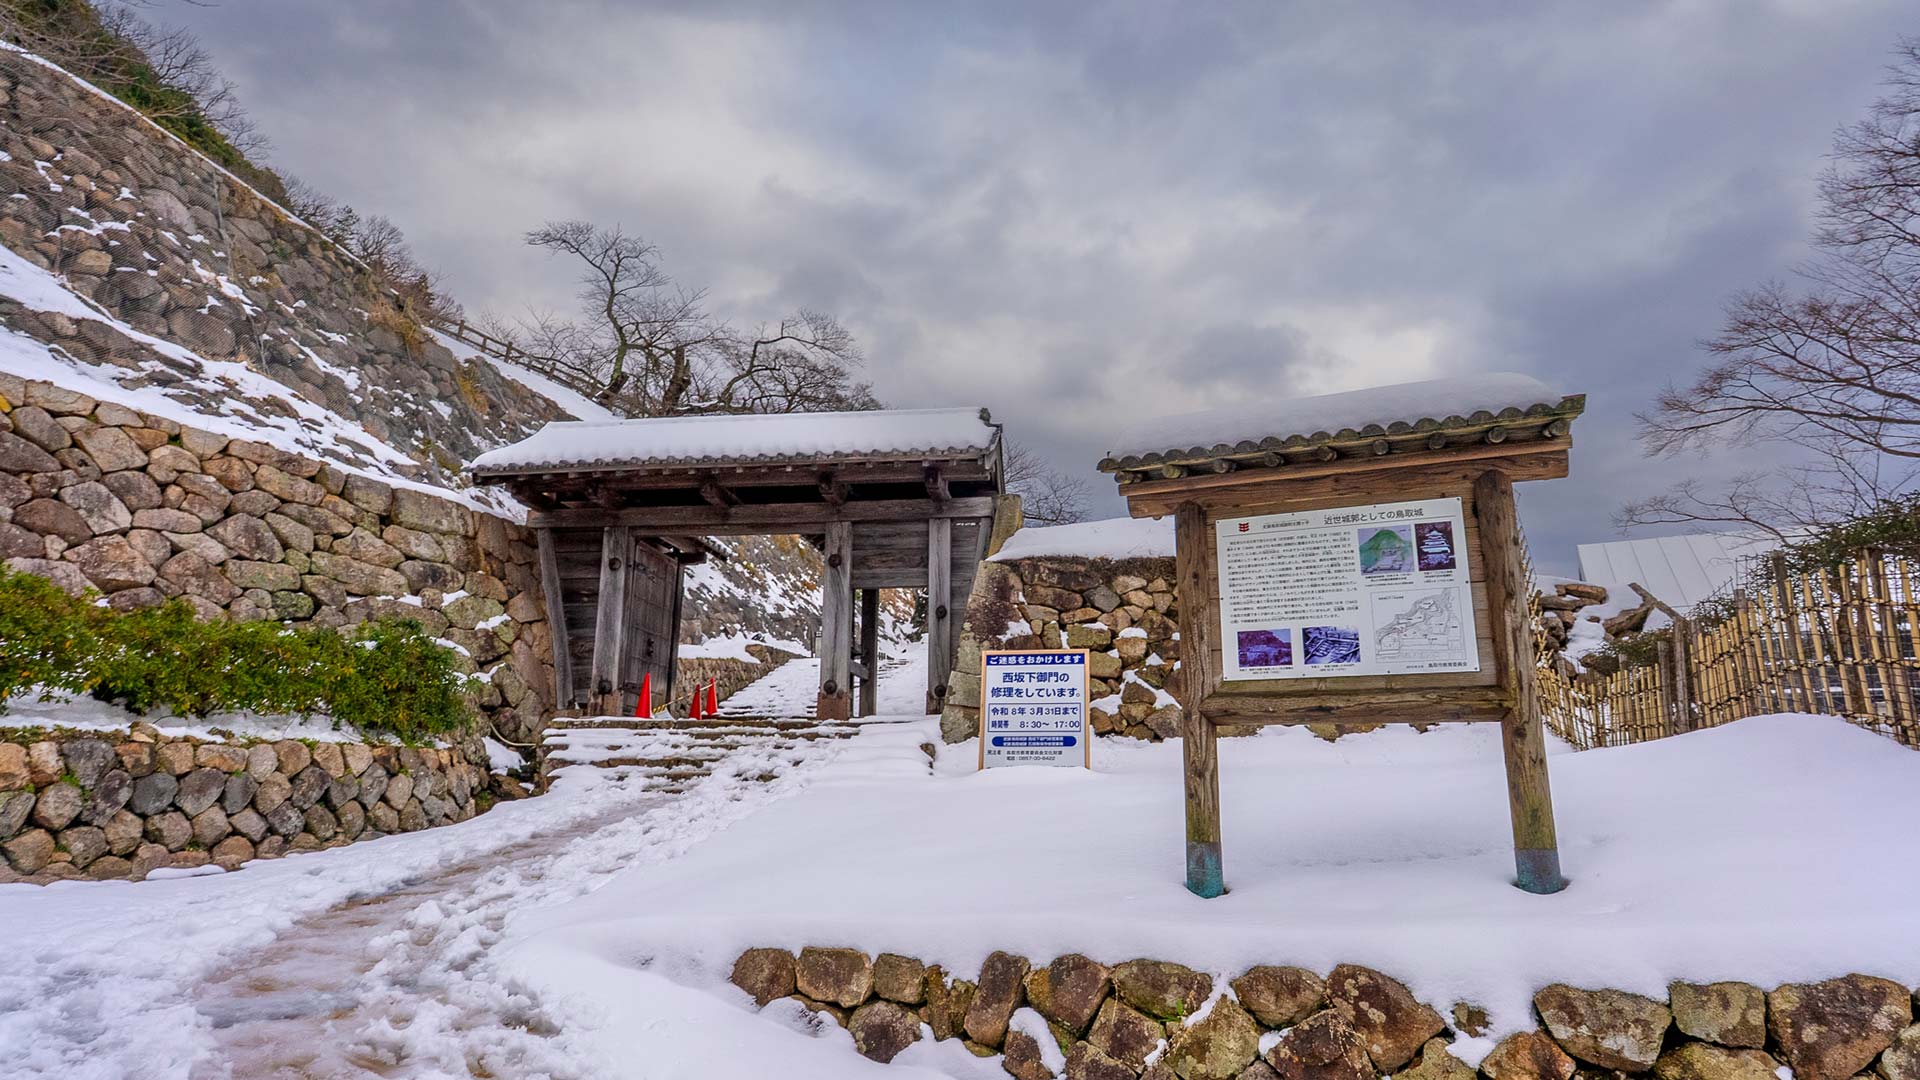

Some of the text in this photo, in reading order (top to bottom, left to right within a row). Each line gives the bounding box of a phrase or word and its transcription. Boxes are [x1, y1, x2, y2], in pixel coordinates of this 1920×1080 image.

[1323, 507, 1424, 525] 近世城郭としての鳥取城
[989, 655, 1082, 665] ご迷惑をおかけします
[1002, 671, 1070, 683] 西坂下御門の
[991, 686, 1080, 698] 修理をしています。
